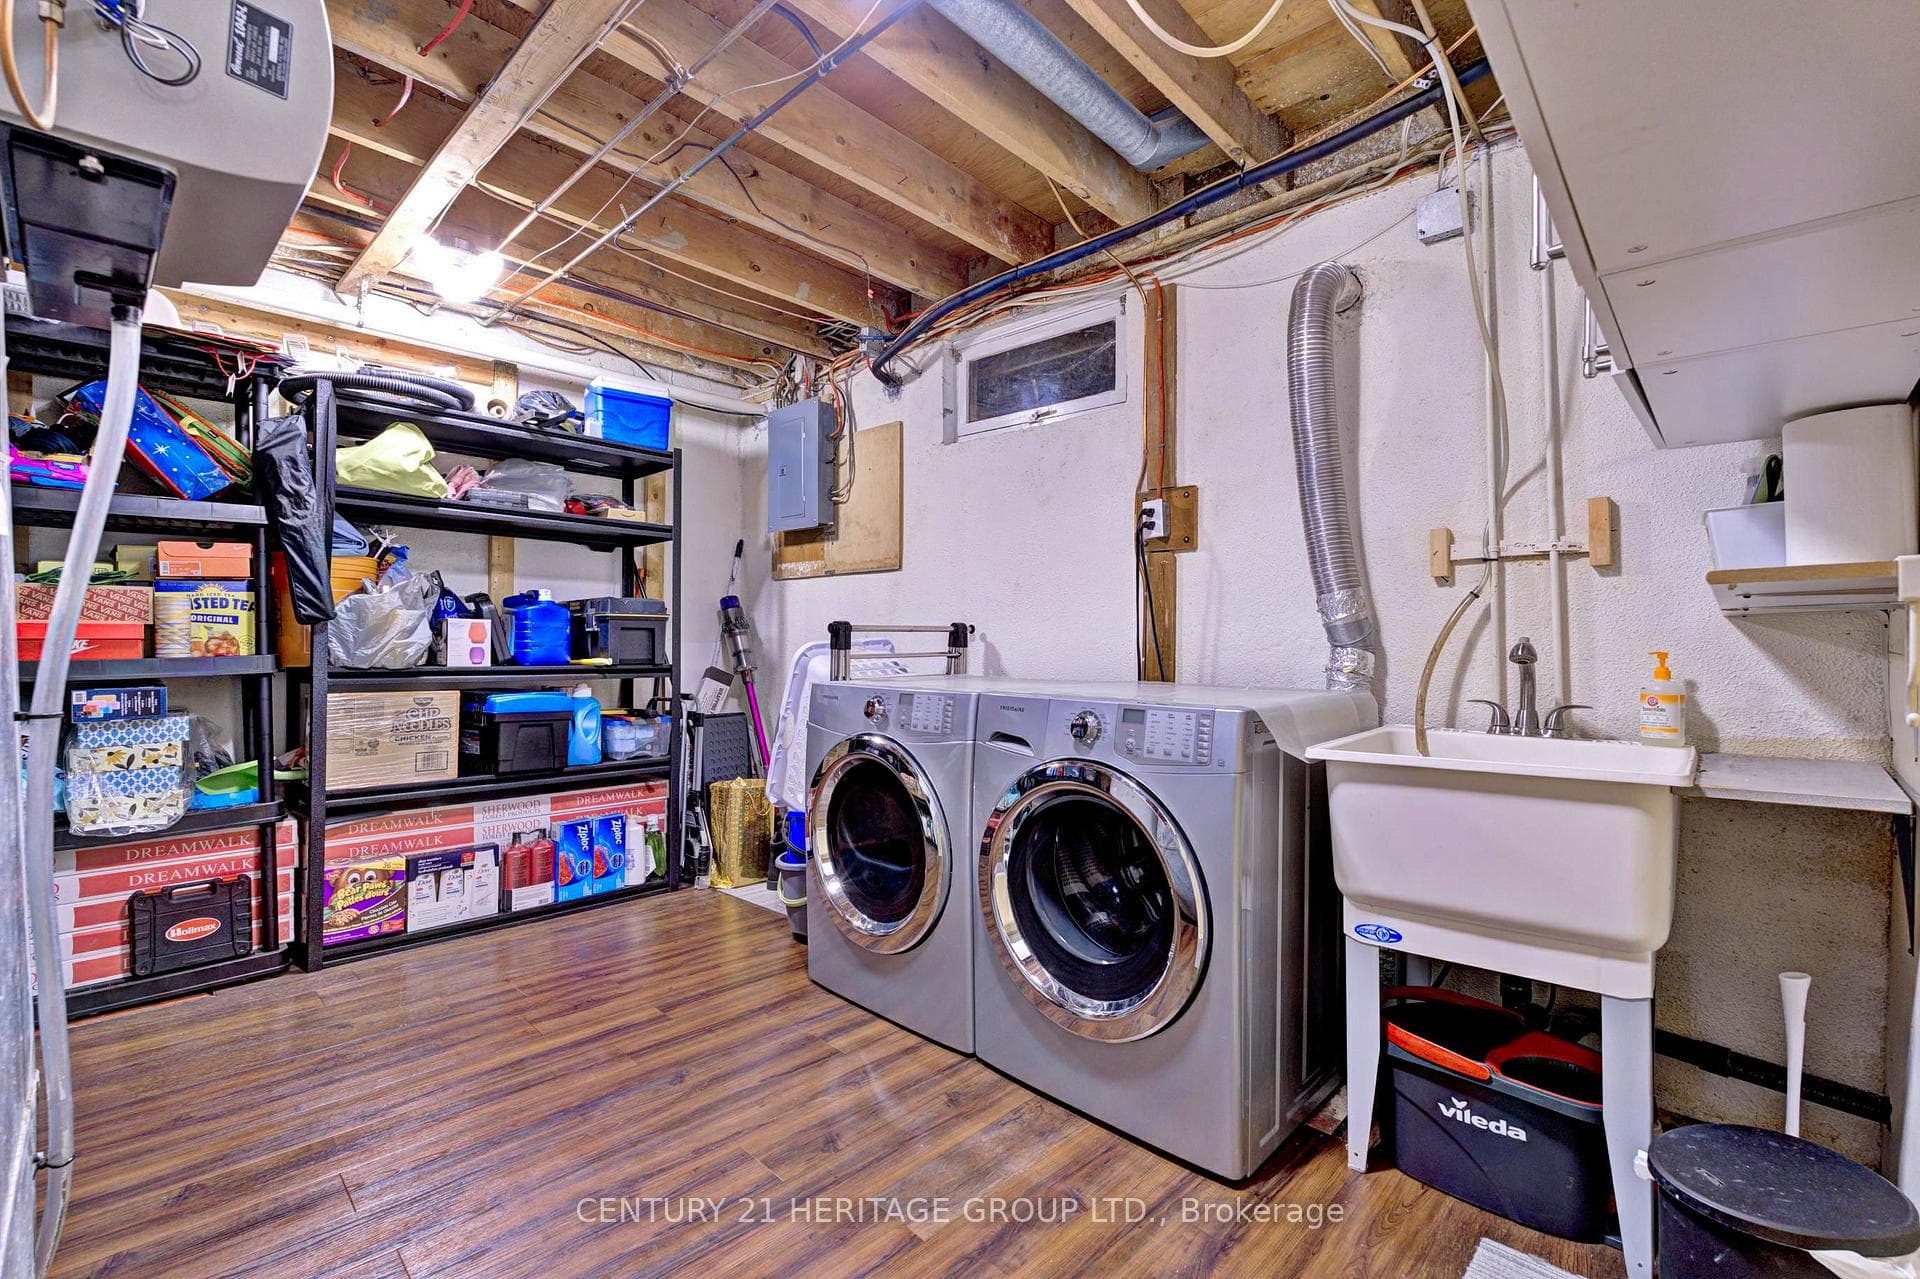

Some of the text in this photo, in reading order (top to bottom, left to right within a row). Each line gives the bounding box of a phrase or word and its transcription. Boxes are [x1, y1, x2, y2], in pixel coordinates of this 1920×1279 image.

[93, 595, 115, 607] VANS
[109, 592, 130, 604] VANS
[128, 589, 147, 602] VANS
[21, 606, 46, 619] VANS
[83, 608, 105, 620] VANS
[100, 606, 122, 618] VANS
[117, 604, 138, 616] VANS
[191, 614, 234, 624] ORIGINAL
[394, 733, 432, 742] CHICKEN
[576, 788, 645, 806] DREAMWALK
[481, 799, 541, 815] SHERWOOD
[348, 813, 444, 835] DREAMWALK
[481, 819, 541, 835] SHERWOOD
[611, 818, 622, 845] Ziploc
[576, 824, 589, 851] Ziploc
[126, 834, 252, 861] DREAMWALK
[349, 835, 444, 858] DREAMWALK
[129, 857, 255, 887] DREAMWALK
[337, 881, 387, 900] Bear Paws
[337, 893, 364, 911] Pattes
[170, 922, 217, 938] Holimax
[1438, 1097, 1527, 1142] vileda
